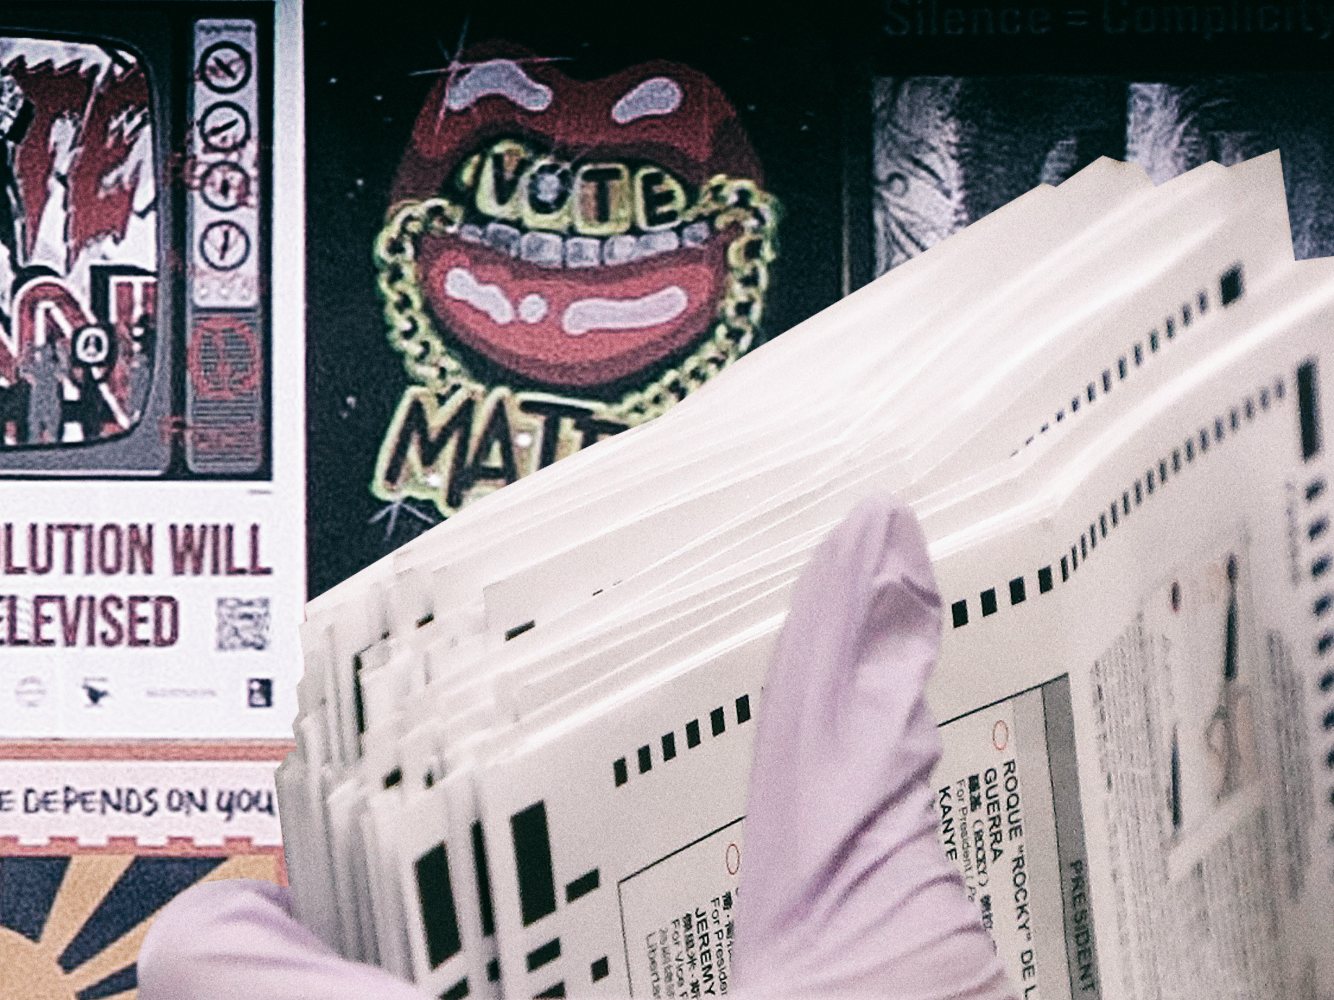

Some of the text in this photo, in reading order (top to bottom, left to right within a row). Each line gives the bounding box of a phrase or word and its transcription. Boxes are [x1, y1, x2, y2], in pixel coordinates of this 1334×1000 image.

[475, 138, 686, 236] VOTE
[371, 385, 633, 520] MATT
[169, 522, 274, 576] WILL
[22, 785, 158, 816] DEPENDS
[166, 785, 208, 816] ON
[984, 767, 1004, 862] GUERRA
[710, 897, 720, 923] For
[1003, 758, 1023, 841] ROQUE
[1020, 950, 1037, 982] DE
[695, 907, 716, 996] JEREMY
[1069, 859, 1098, 994] PRESIDENT
